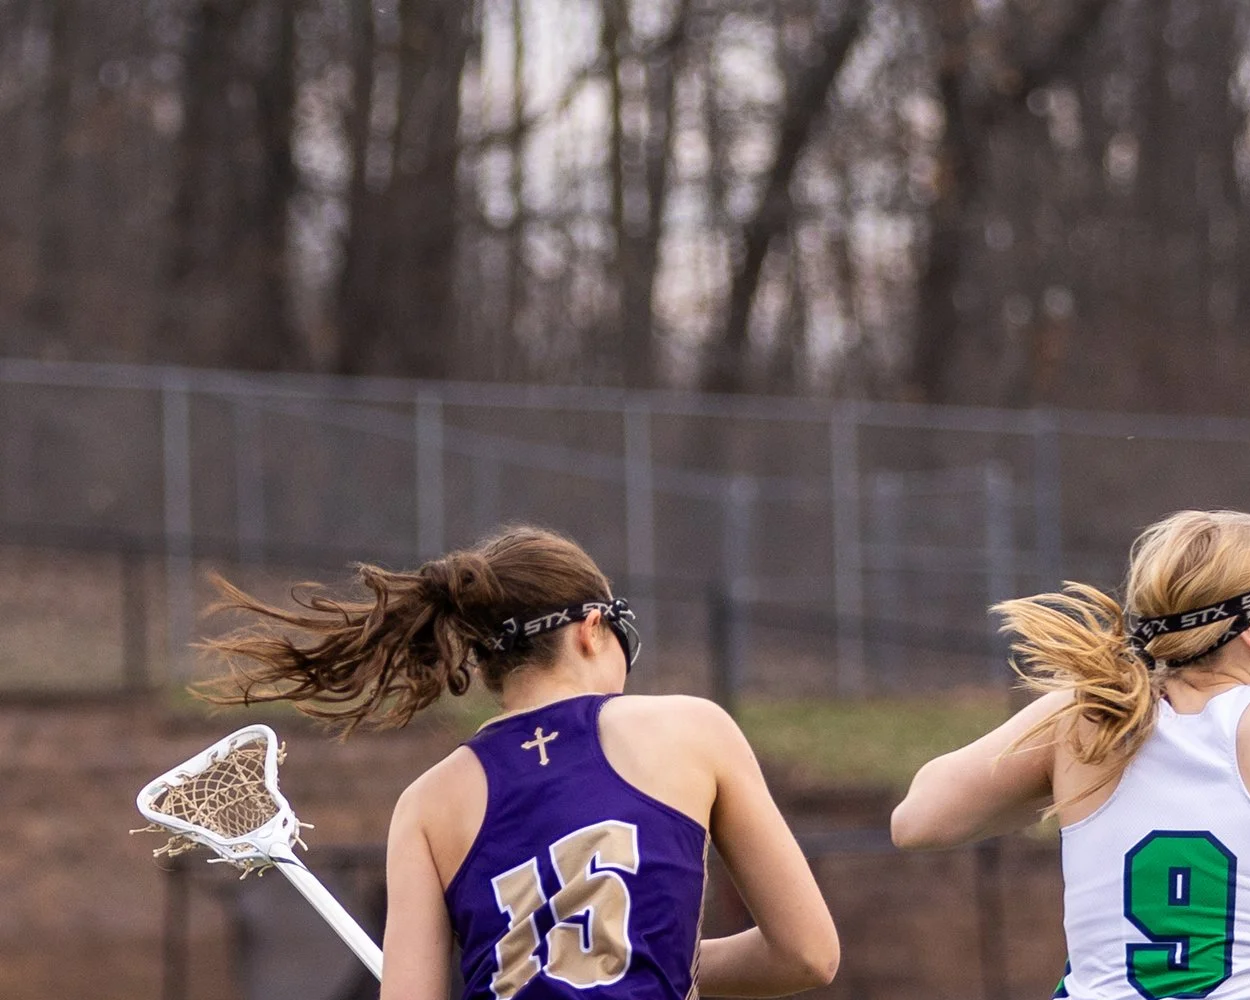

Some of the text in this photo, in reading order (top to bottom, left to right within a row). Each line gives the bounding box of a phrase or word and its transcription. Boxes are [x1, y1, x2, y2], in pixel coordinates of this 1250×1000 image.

[523, 608, 572, 636] STX
[582, 602, 615, 618] STX
[1180, 603, 1229, 629] STX
